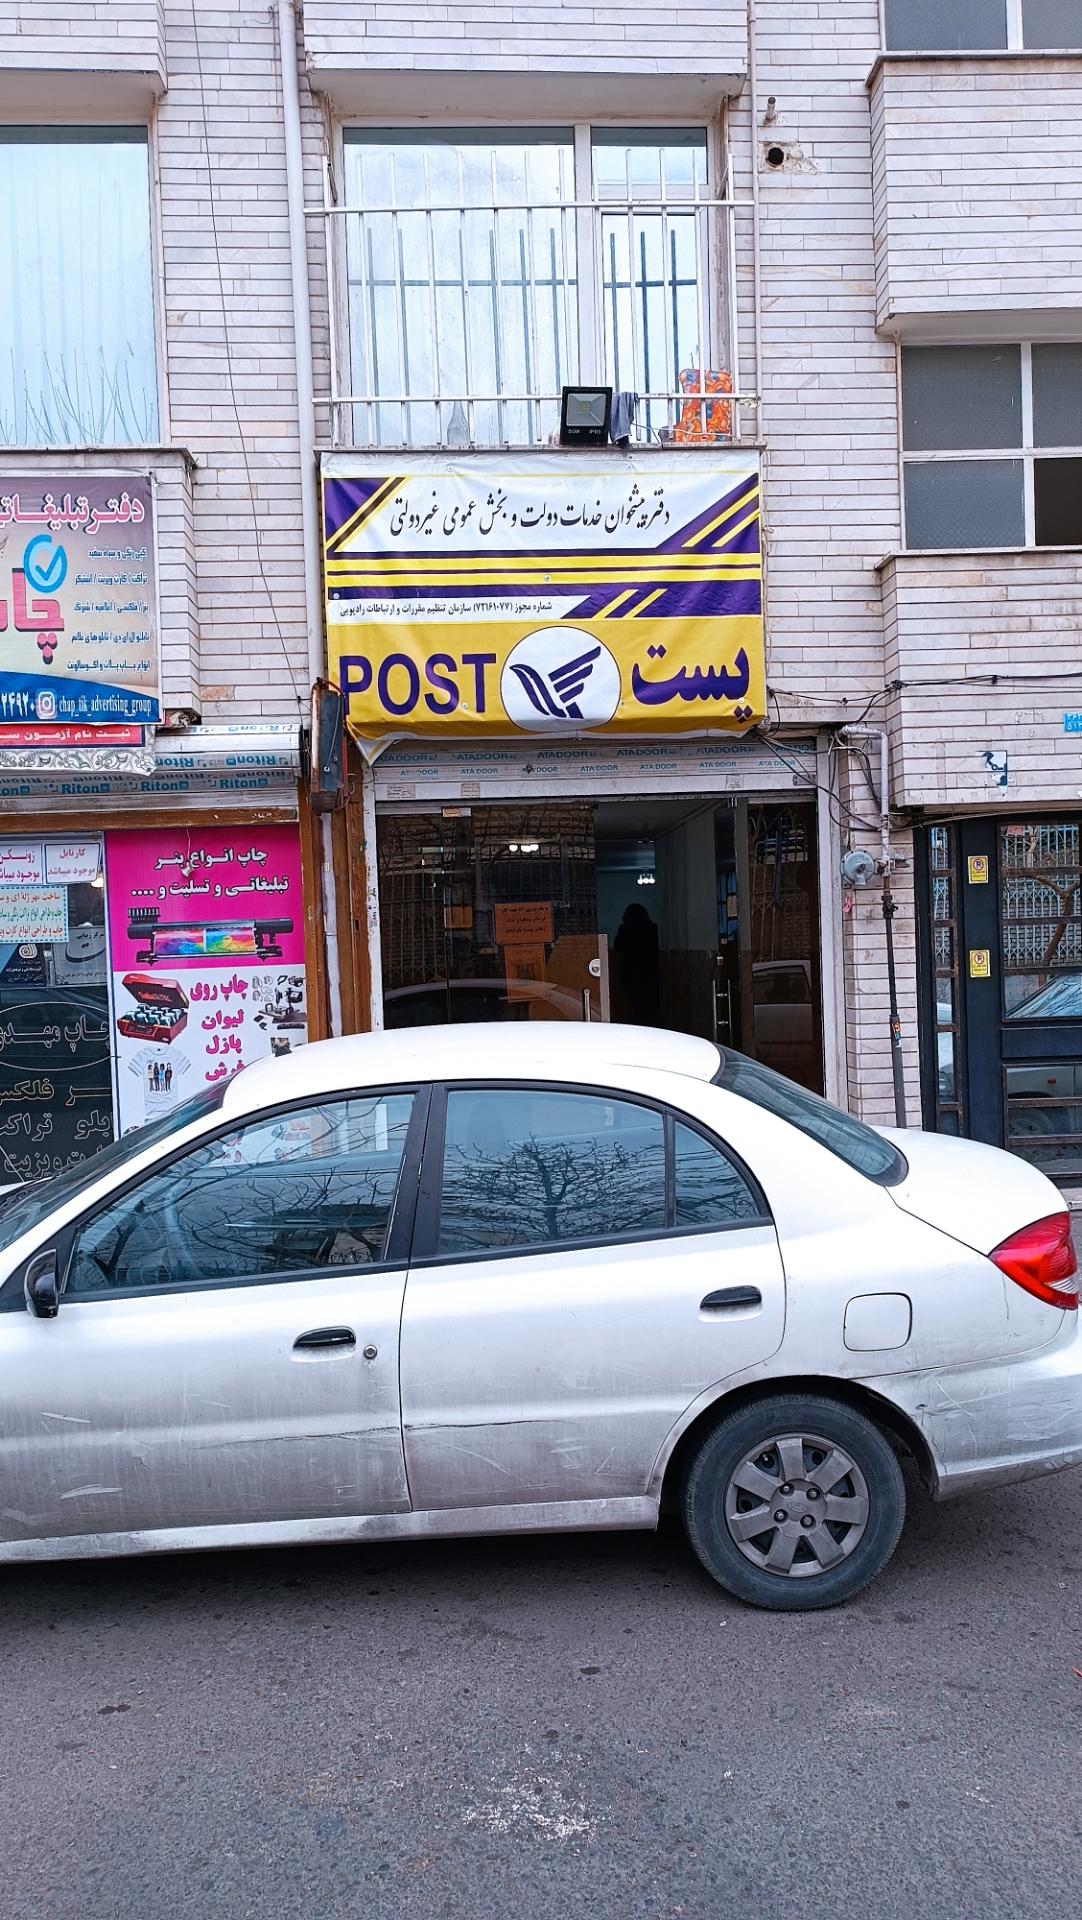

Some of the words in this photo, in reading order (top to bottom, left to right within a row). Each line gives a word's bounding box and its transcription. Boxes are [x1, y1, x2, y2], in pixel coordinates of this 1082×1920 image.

[84, 493, 145, 535] دفتر
[479, 488, 507, 535] بخش
[521, 501, 558, 527] دولت
[560, 500, 602, 526] خدمات
[605, 483, 647, 533] پیشخوان
[644, 487, 669, 529] دفتر
[443, 500, 476, 536] عمومی
[511, 513, 517, 527] و
[340, 603, 365, 617] رادیویی
[366, 603, 394, 615] ارتباطات
[402, 603, 425, 616] مقررات
[427, 603, 446, 614] تنظیم
[448, 602, 471, 615] سازمان
[515, 602, 531, 613] مجوز
[533, 601, 552, 613] شماره
[339, 653, 497, 715] POST
[631, 644, 750, 725] پست
[24, 729, 71, 740] آزمون
[74, 730, 92, 741] نام
[96, 728, 131, 739] ثبت
[236, 755, 276, 766] Riton
[476, 767, 499, 775] DOOR
[61, 783, 100, 794] Riton
[140, 781, 178, 791] Riton
[220, 779, 257, 789] Riton
[154, 851, 184, 870] بنر
[189, 848, 234, 868] انواع
[237, 847, 268, 867] چاپ
[169, 879, 211, 898] تسلیت
[213, 884, 223, 898] و
[225, 875, 289, 897] تبلیغاتی
[157, 887, 167, 900] و
[189, 981, 218, 1002] روی
[220, 974, 249, 1001] چاپ
[201, 1008, 245, 1030] لیوان
